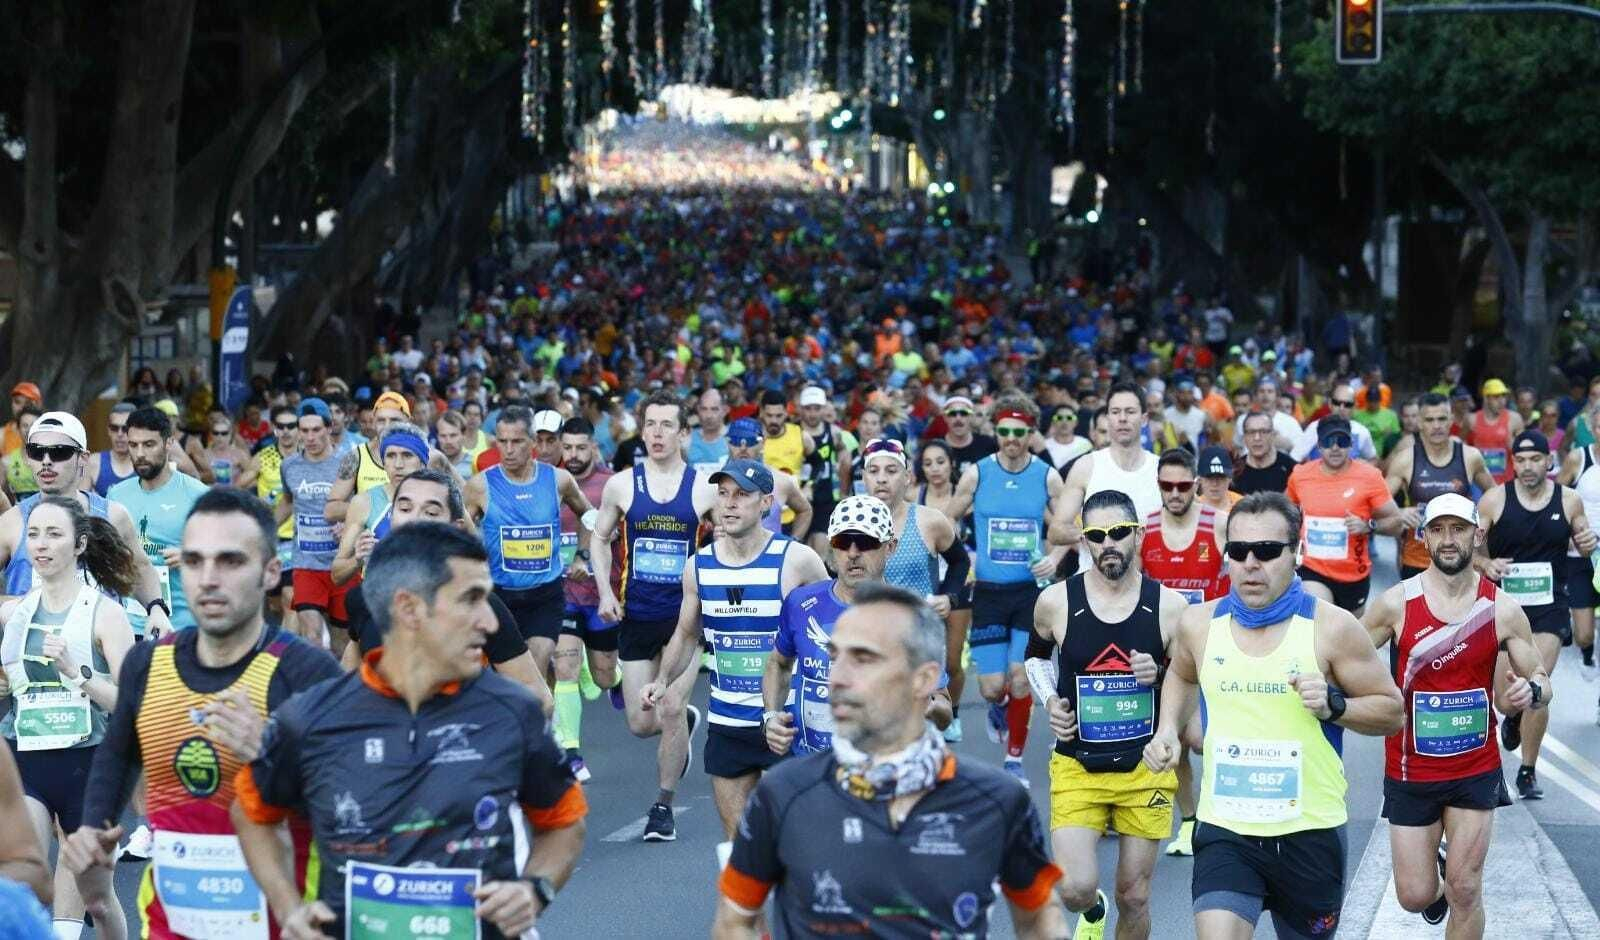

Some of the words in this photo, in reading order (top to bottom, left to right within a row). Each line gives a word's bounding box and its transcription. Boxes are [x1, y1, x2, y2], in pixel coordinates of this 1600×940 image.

[298, 479, 334, 494] Azore
[635, 521, 688, 531] HEATHSIDE
[734, 638, 761, 646] ZURICH
[741, 658, 762, 667] 719
[803, 657, 827, 669] OWL
[1107, 681, 1138, 689] ZURICH
[1220, 681, 1243, 692] C.A.
[1247, 682, 1287, 694] LIEBRE
[1116, 701, 1138, 711] 994
[1443, 696, 1474, 705] ZURICH
[44, 712, 77, 724] 5506
[1452, 715, 1473, 726] 802
[1243, 747, 1281, 758] ZURICH
[1248, 772, 1285, 786] 4867
[197, 877, 245, 895] 4830
[398, 879, 453, 894] ZURICH
[409, 915, 451, 934] 668
